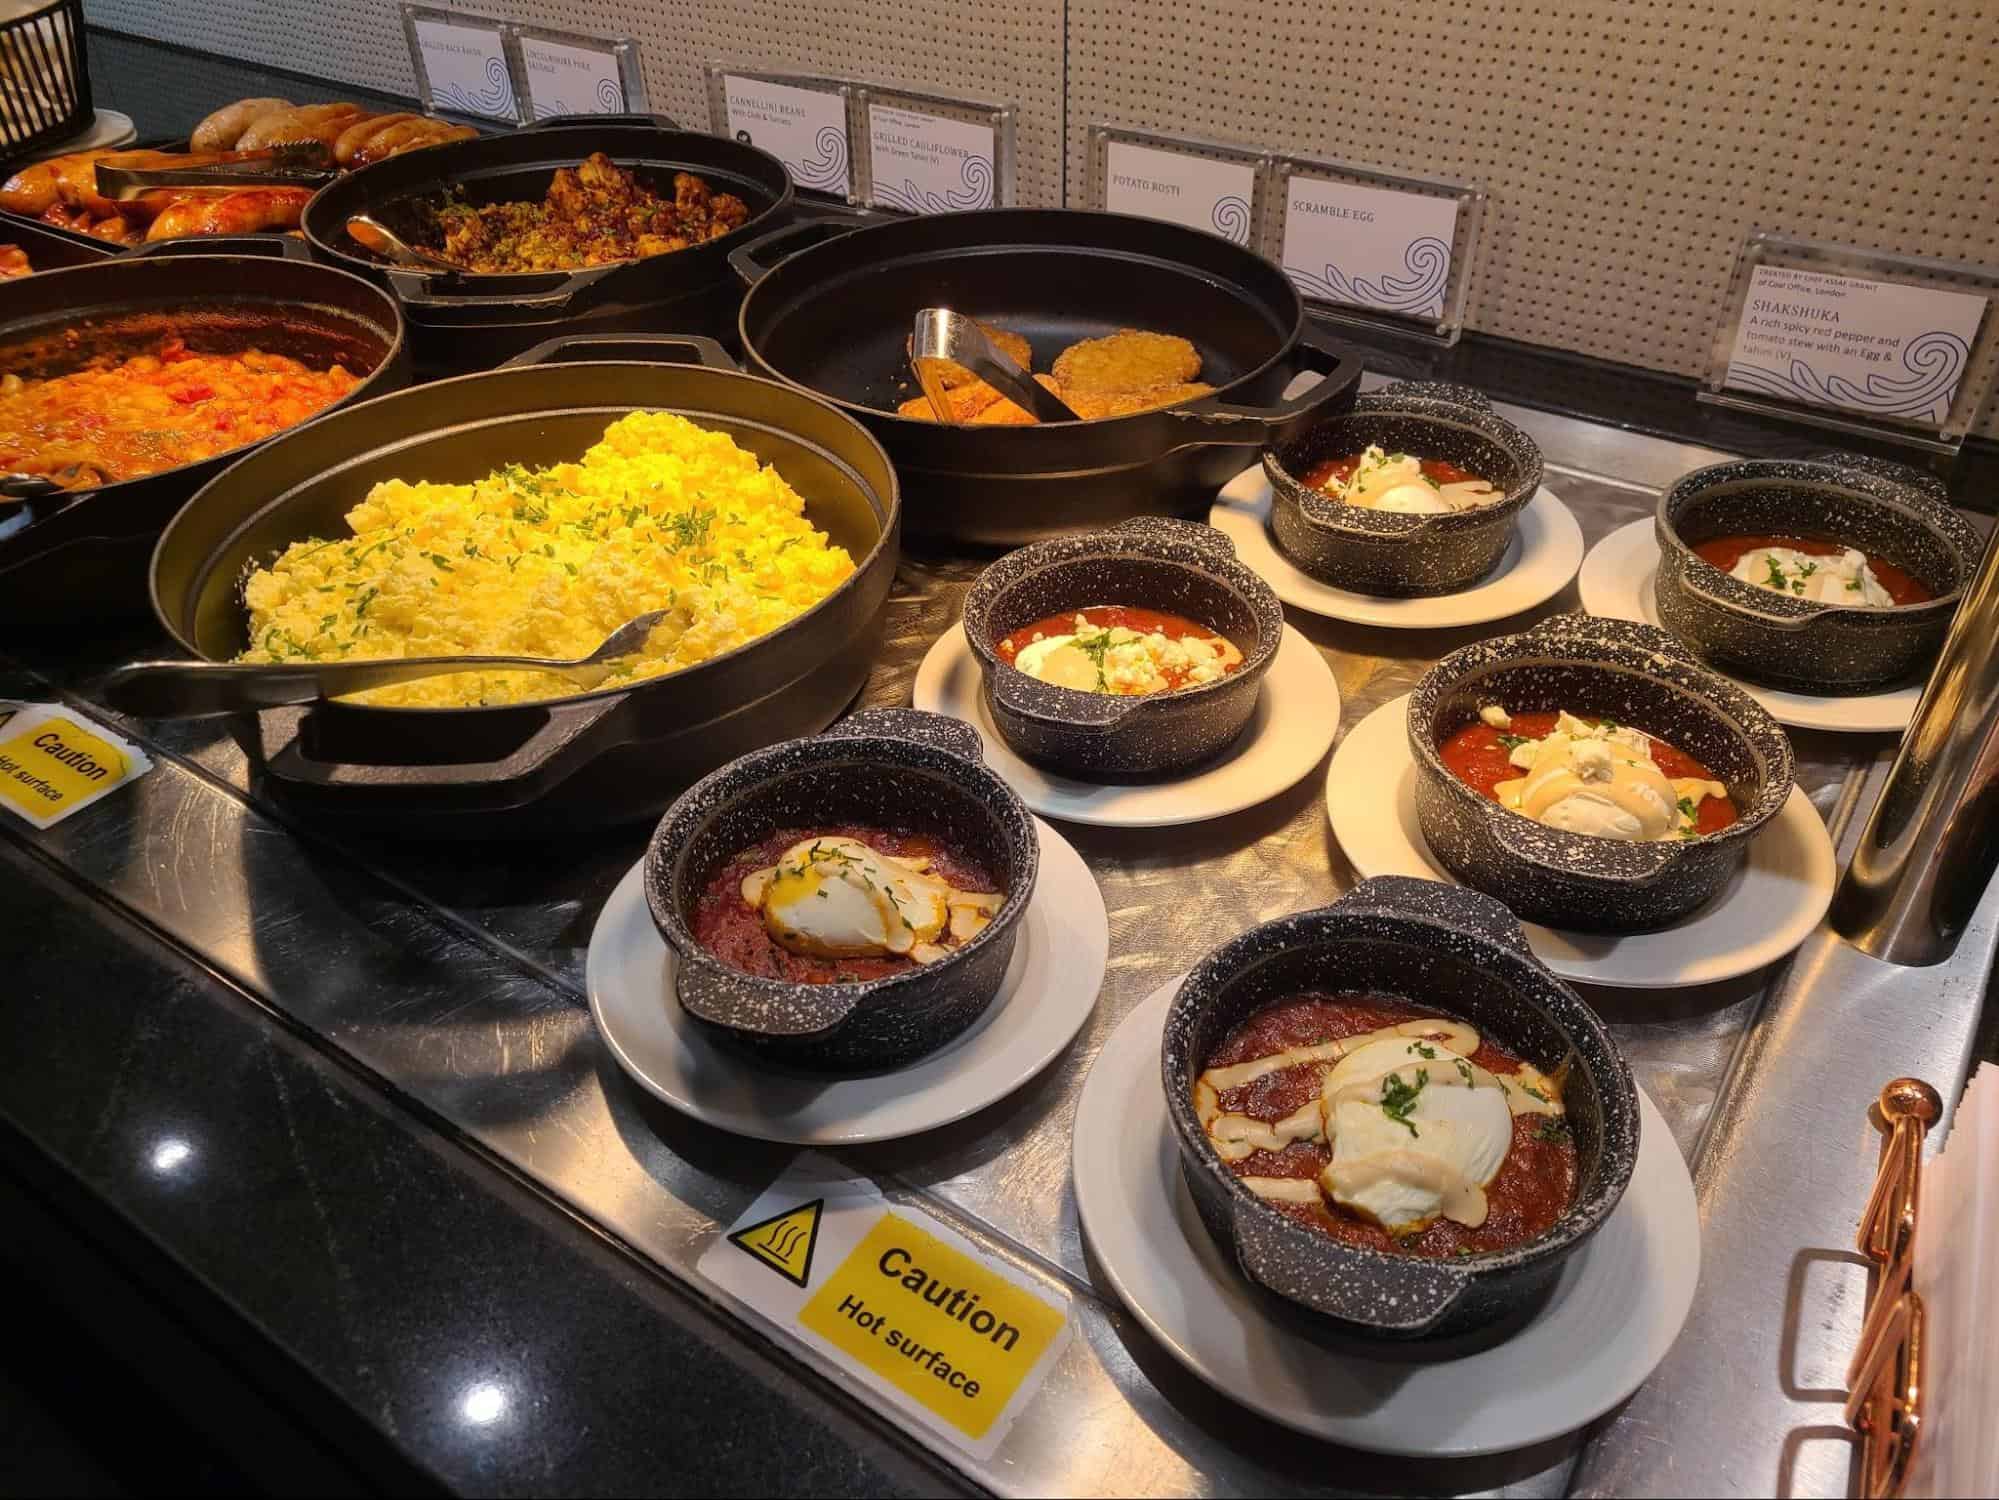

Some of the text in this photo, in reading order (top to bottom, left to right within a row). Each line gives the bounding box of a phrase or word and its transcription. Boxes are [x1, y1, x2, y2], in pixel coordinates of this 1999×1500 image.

[730, 95, 806, 118] CANNELLINI BEANS
[872, 131, 969, 159] GRILLED CAULIFLOWER
[1113, 175, 1180, 198] POTATO ROSTI
[1293, 201, 1375, 223] SCRAMBLE EGG
[1815, 287, 1847, 297] London
[1752, 299, 1840, 323] SHAKSHUKA
[1750, 315, 1900, 347] A rich spicy red pepper and
[1746, 331, 1892, 362] tomato stew with an Egg &
[34, 733, 108, 781] Caution
[14, 770, 63, 801] surface
[878, 1247, 1020, 1352] Caution
[837, 1294, 981, 1398] Hot surface
